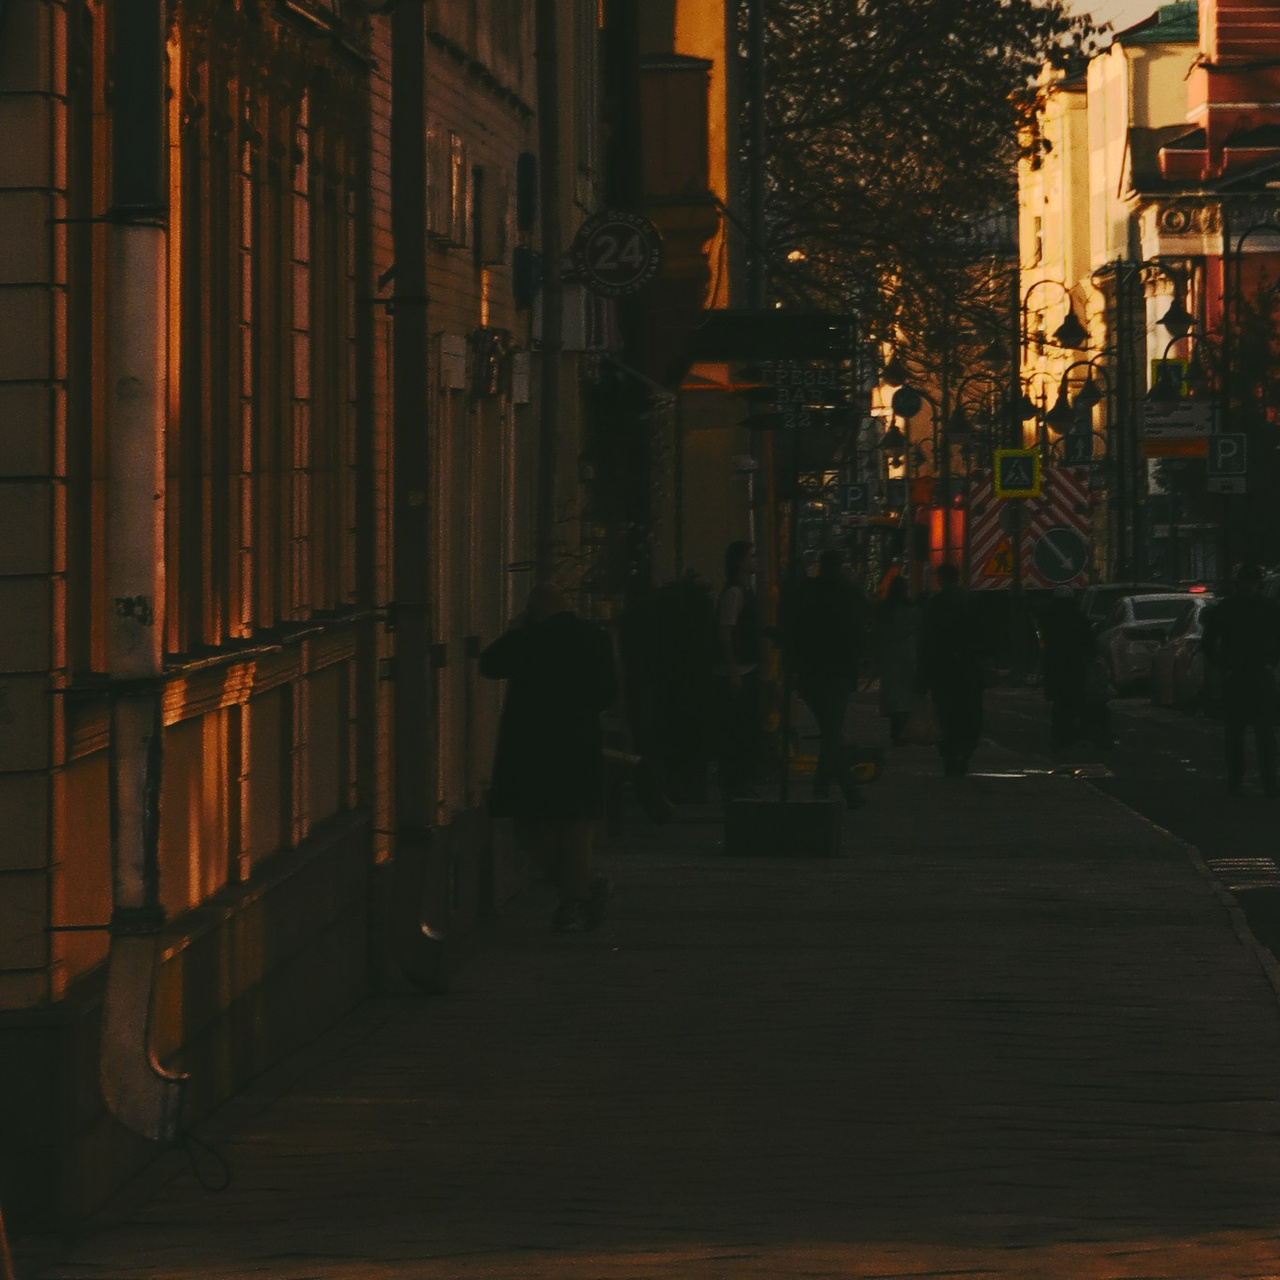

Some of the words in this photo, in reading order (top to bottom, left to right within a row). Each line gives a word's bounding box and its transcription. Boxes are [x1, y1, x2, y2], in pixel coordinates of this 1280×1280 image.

[594, 235, 643, 270] 24
[763, 370, 837, 385] ГРЕЗЫ
[1217, 439, 1238, 469] P
[847, 486, 864, 508] P
